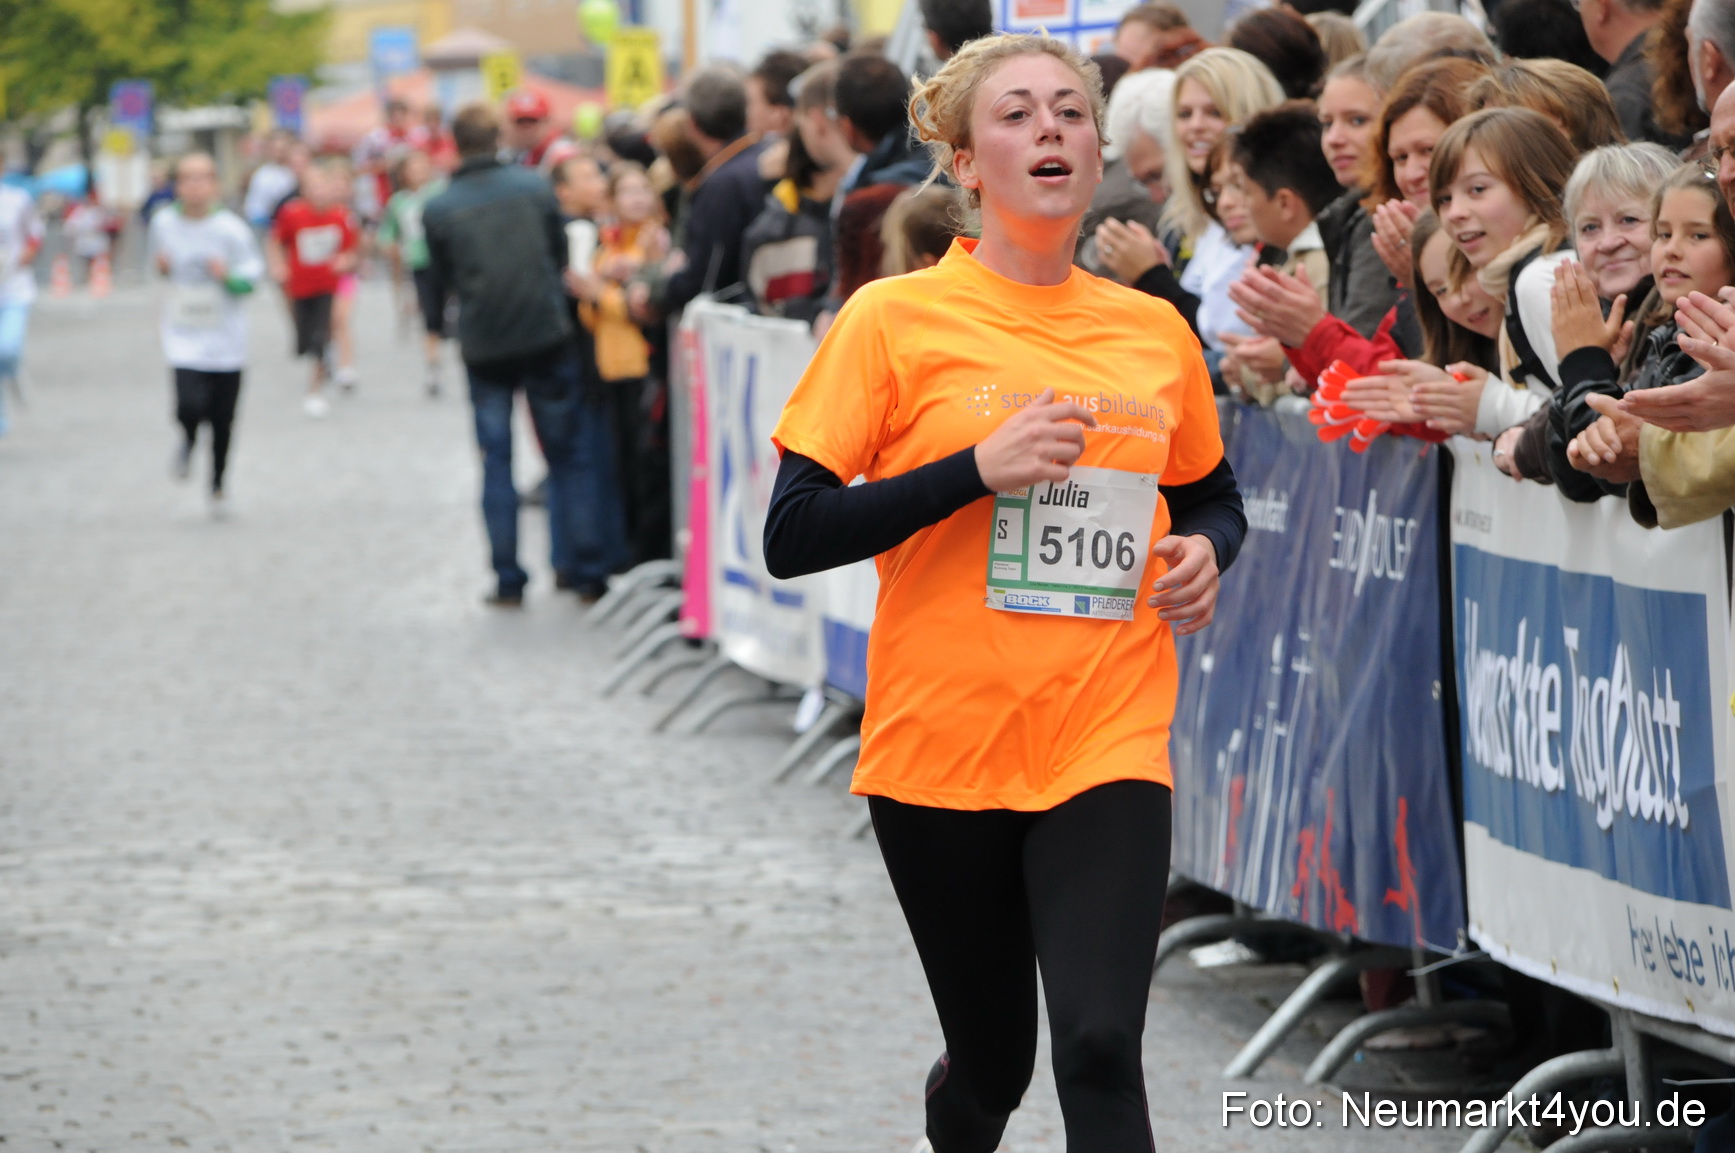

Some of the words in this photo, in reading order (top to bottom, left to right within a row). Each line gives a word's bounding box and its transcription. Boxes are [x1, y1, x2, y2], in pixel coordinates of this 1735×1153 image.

[1000, 391, 1044, 409] star
[1038, 480, 1090, 508] Julia
[997, 519, 1008, 540] S
[1038, 525, 1136, 572] 5106
[1004, 593, 1050, 607] BOCK
